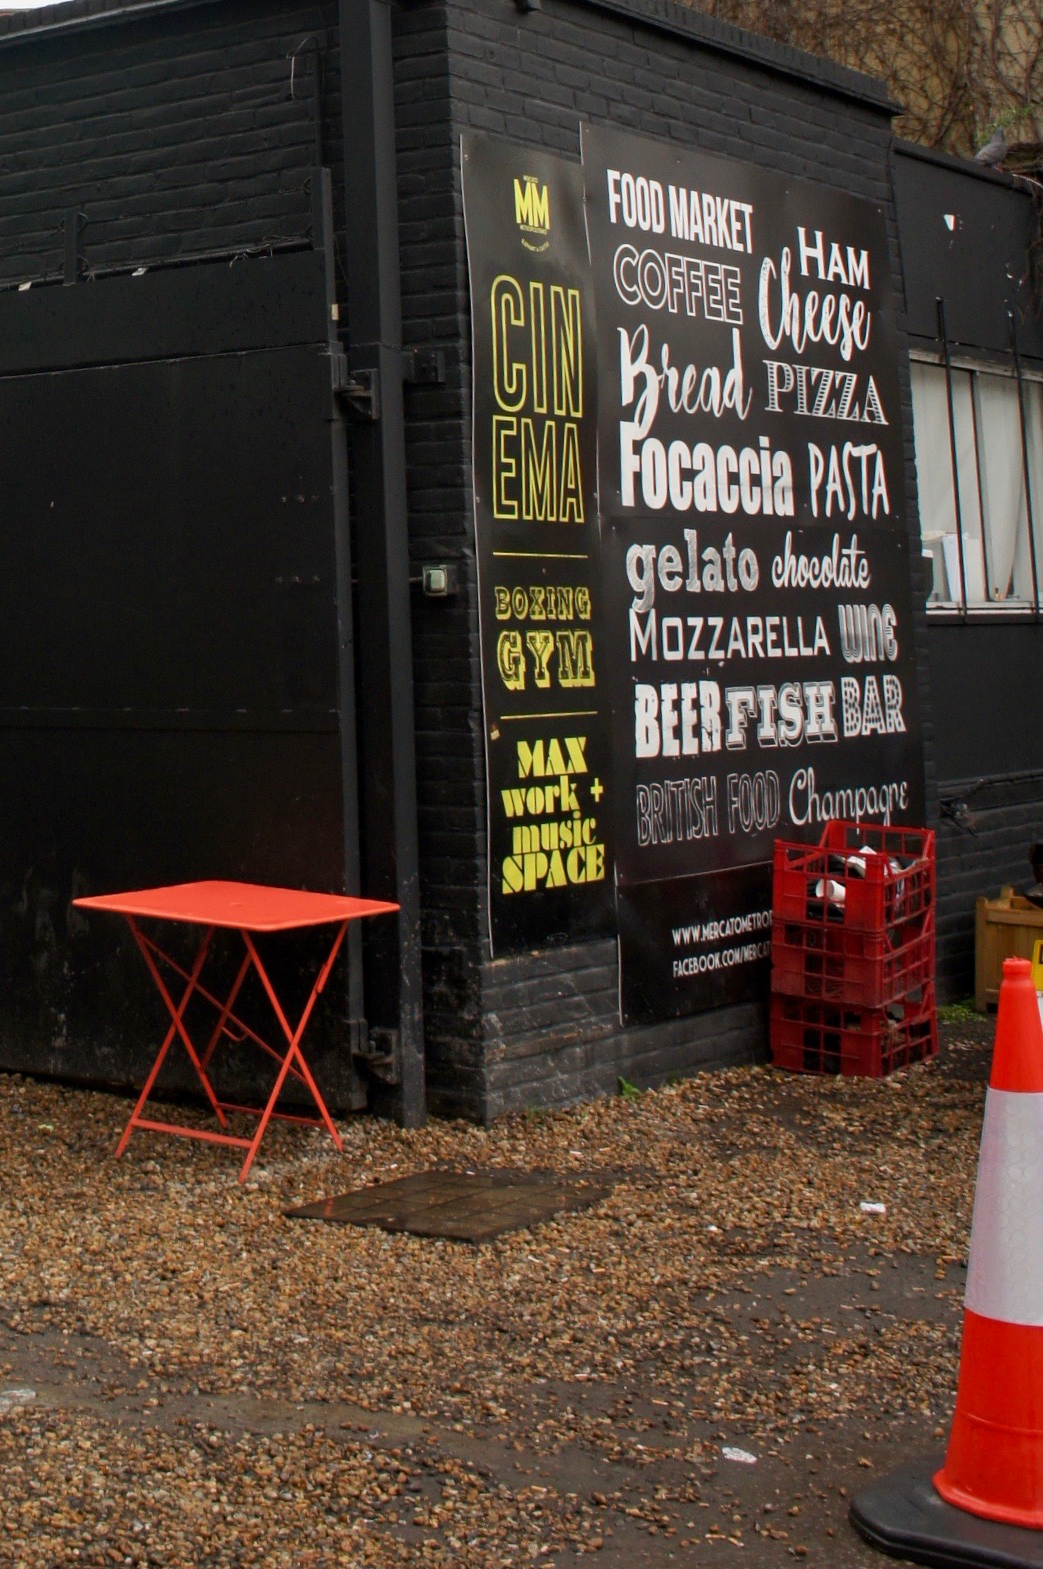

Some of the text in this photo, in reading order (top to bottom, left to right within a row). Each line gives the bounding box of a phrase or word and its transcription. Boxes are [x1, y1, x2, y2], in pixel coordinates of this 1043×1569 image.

[514, 178, 551, 230] MM
[607, 169, 753, 254] FOOD MARKET
[613, 243, 744, 325] COFFEE
[797, 226, 871, 290] HAM
[758, 246, 872, 362] Cheese
[490, 274, 583, 418] CIN
[616, 323, 753, 442] Bread
[762, 359, 890, 425] PIZZA
[492, 415, 585, 523] EMA
[619, 421, 890, 521] Focaccia PASTA
[494, 587, 591, 620] BOXING
[625, 528, 871, 613] gelato chocolate
[496, 630, 595, 690] GYM
[628, 607, 831, 662] MOZZARELLA
[634, 674, 907, 759] BEER FISH BAR
[517, 736, 588, 778] MAX
[501, 775, 581, 818] work
[636, 766, 908, 847] BRITISH FOOD Champagne
[513, 810, 596, 855] music
[502, 844, 605, 895] SPACE
[673, 940, 772, 978] FACEBOOK.COM/MERCAT
